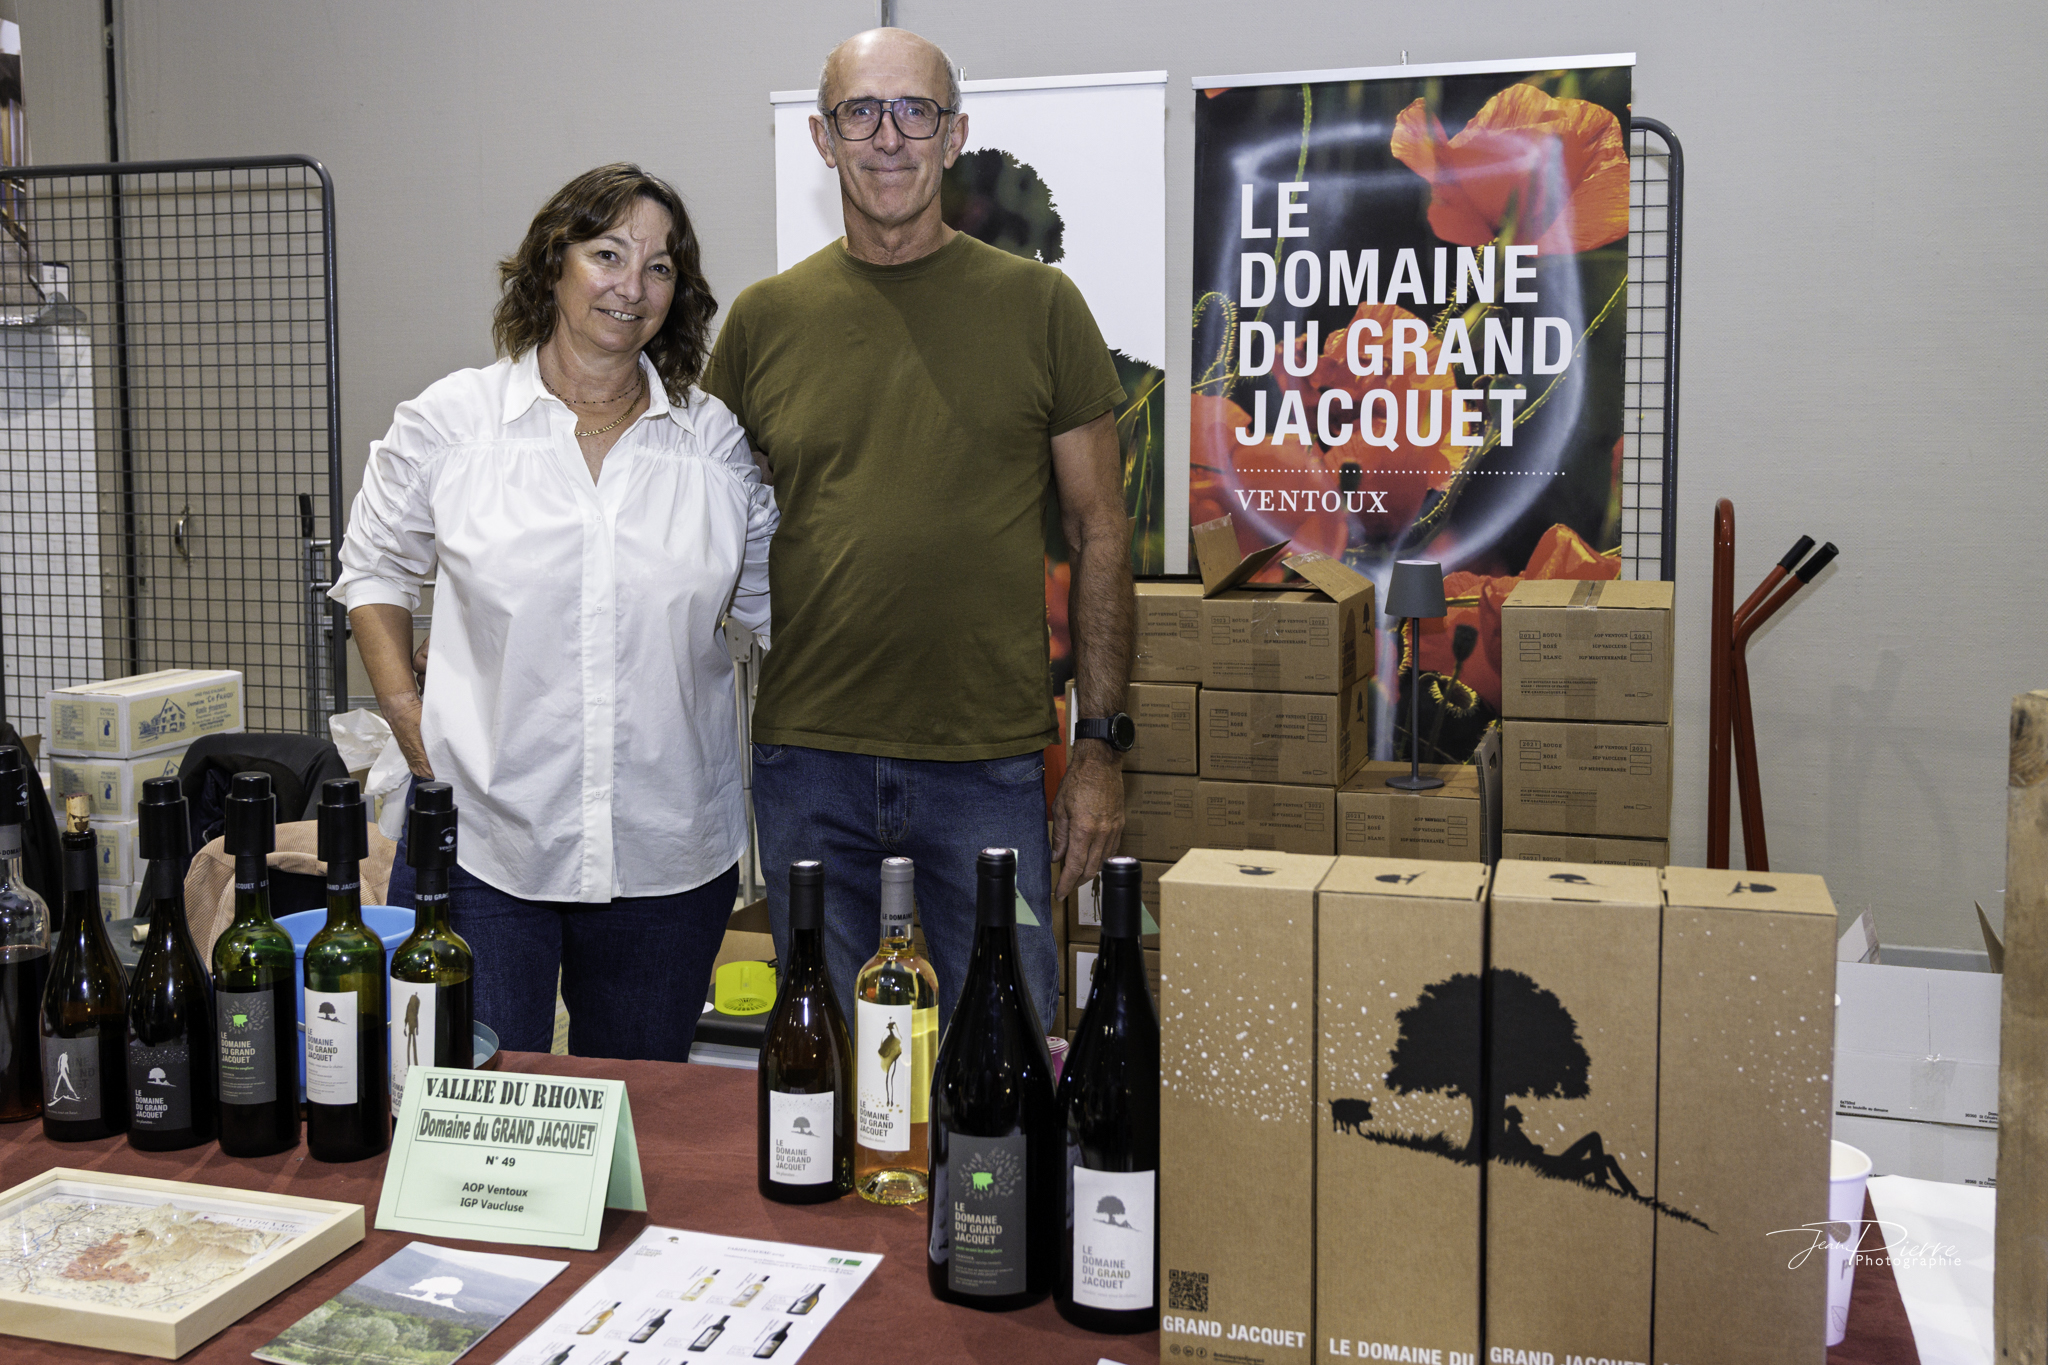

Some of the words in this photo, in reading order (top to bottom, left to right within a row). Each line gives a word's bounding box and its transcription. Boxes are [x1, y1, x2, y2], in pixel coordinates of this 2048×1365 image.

[1240, 182, 1310, 239] LE
[1239, 245, 1539, 308] DOMAINE
[1238, 320, 1320, 377] DU
[1346, 317, 1573, 376] GRAND
[1234, 389, 1527, 452] JACQUET
[1234, 489, 1389, 514] VENTOUX
[221, 1039, 251, 1048] DOMAINE
[308, 1037, 333, 1046] DOMAINE
[222, 1054, 250, 1064] JACQUET
[308, 1052, 333, 1062] JACQUET
[426, 1078, 497, 1104] VALLEE
[500, 1080, 530, 1106] DU
[532, 1084, 605, 1110] RHONE
[860, 1110, 889, 1121] DOMAINE
[860, 1116, 867, 1124] DU
[868, 1119, 894, 1129] GRAND
[418, 1111, 471, 1141] Domaine
[473, 1116, 488, 1142] du
[491, 1117, 536, 1146] GRAND
[536, 1120, 596, 1150] JACQUET
[860, 1125, 888, 1137] JACQUET
[776, 1146, 807, 1156] DOMAINE
[486, 1155, 499, 1165] N°
[501, 1156, 516, 1167] 49
[776, 1154, 785, 1162] DU
[786, 1155, 811, 1164] GRAND
[776, 1162, 806, 1171] JACQUET
[462, 1182, 485, 1193] AOP
[486, 1184, 529, 1198] Ventoux
[460, 1197, 478, 1209] IGP
[480, 1199, 524, 1213] Vaucluse
[955, 1201, 965, 1211] LE
[955, 1212, 998, 1224] DOMAINE
[955, 1222, 967, 1231] DU
[969, 1224, 1002, 1235] GRAND
[955, 1232, 996, 1245] JACQUET
[1082, 1245, 1093, 1255] LE
[1082, 1255, 1125, 1268] DOMAINE
[1082, 1265, 1094, 1276] DU
[1097, 1268, 1130, 1279] GRAND
[1082, 1275, 1124, 1289] JACQUET
[1163, 1315, 1222, 1338] GRAND
[1227, 1324, 1306, 1348] JACQUET
[1329, 1338, 1351, 1356] LE
[1358, 1340, 1442, 1365] DOMAINE
[1450, 1351, 1474, 1365] DU
[1490, 1346, 1555, 1365] GRAND
